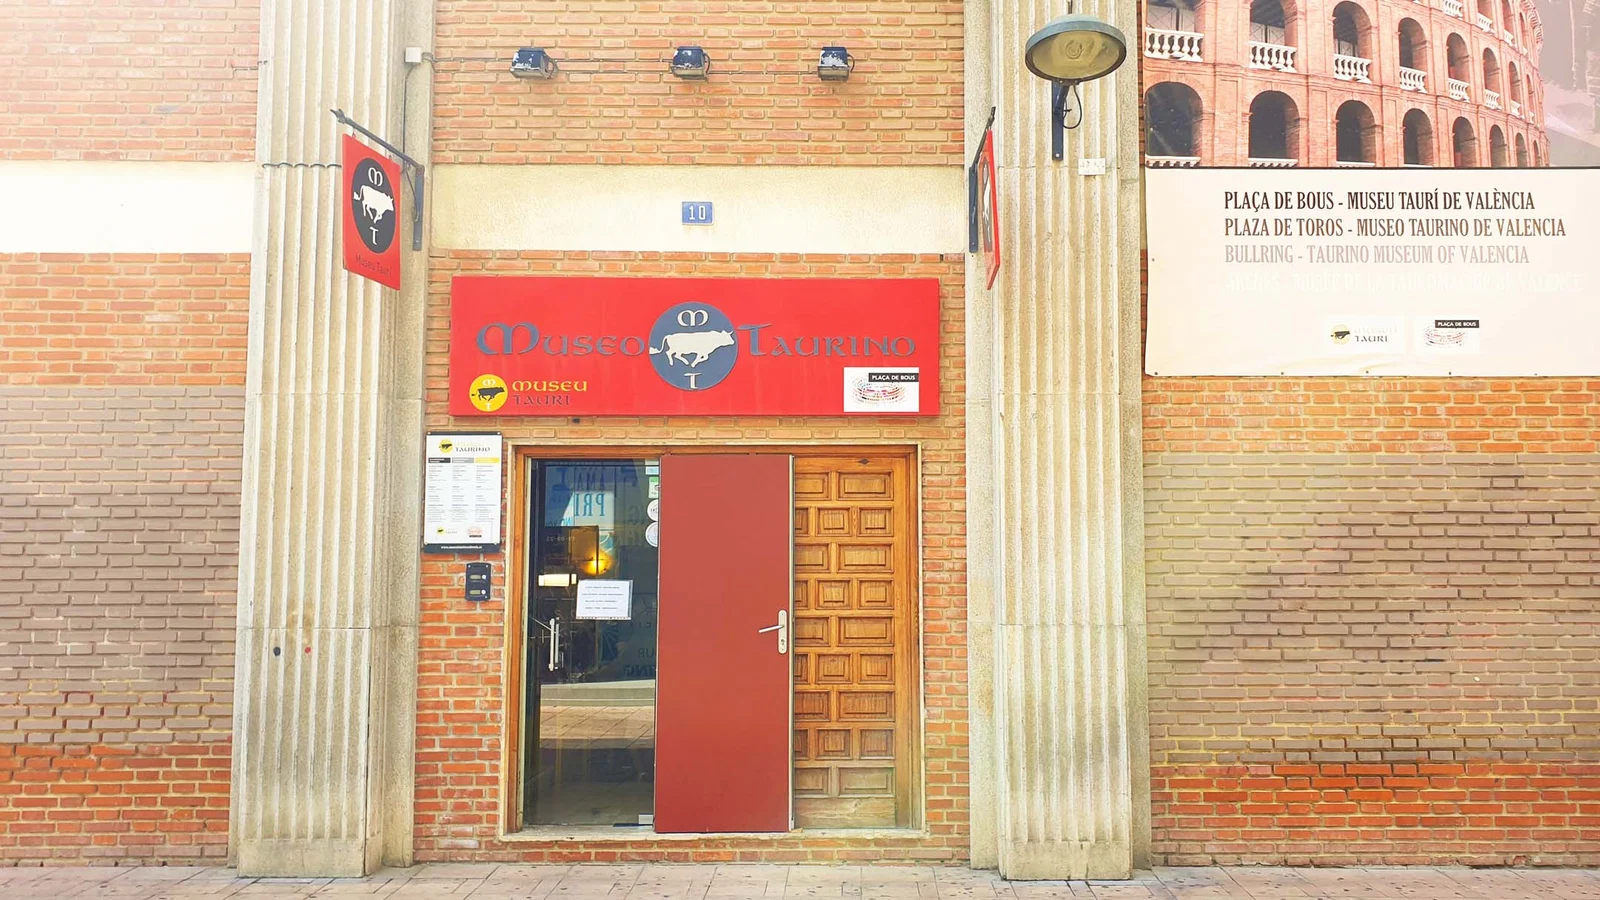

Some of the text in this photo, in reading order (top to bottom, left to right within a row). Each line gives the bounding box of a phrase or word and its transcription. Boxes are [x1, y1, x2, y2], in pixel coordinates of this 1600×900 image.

[1224, 191, 1270, 213] PLAÇA
[1274, 191, 1293, 210] DE
[1297, 191, 1334, 210] BOUS
[1347, 191, 1394, 210] MUSEU
[1398, 188, 1439, 210] TAURÍ
[1443, 191, 1462, 210] DE
[1465, 188, 1535, 210] VALÈNCIA
[688, 205, 706, 220] 10
[1224, 218, 1270, 237] PLAZA
[1274, 218, 1293, 237] DE
[1296, 218, 1343, 237] TOROS
[1357, 218, 1404, 237] MUSEO
[1408, 218, 1469, 237] TAURINO
[1473, 218, 1492, 237] DE
[1496, 218, 1566, 237] VALENCIA
[1225, 245, 1293, 263] BULLRING
[1307, 245, 1369, 263] TAURINO
[1374, 245, 1433, 263] MUSEUM
[1438, 245, 1455, 263] OF
[1460, 245, 1529, 263] VALENCIA
